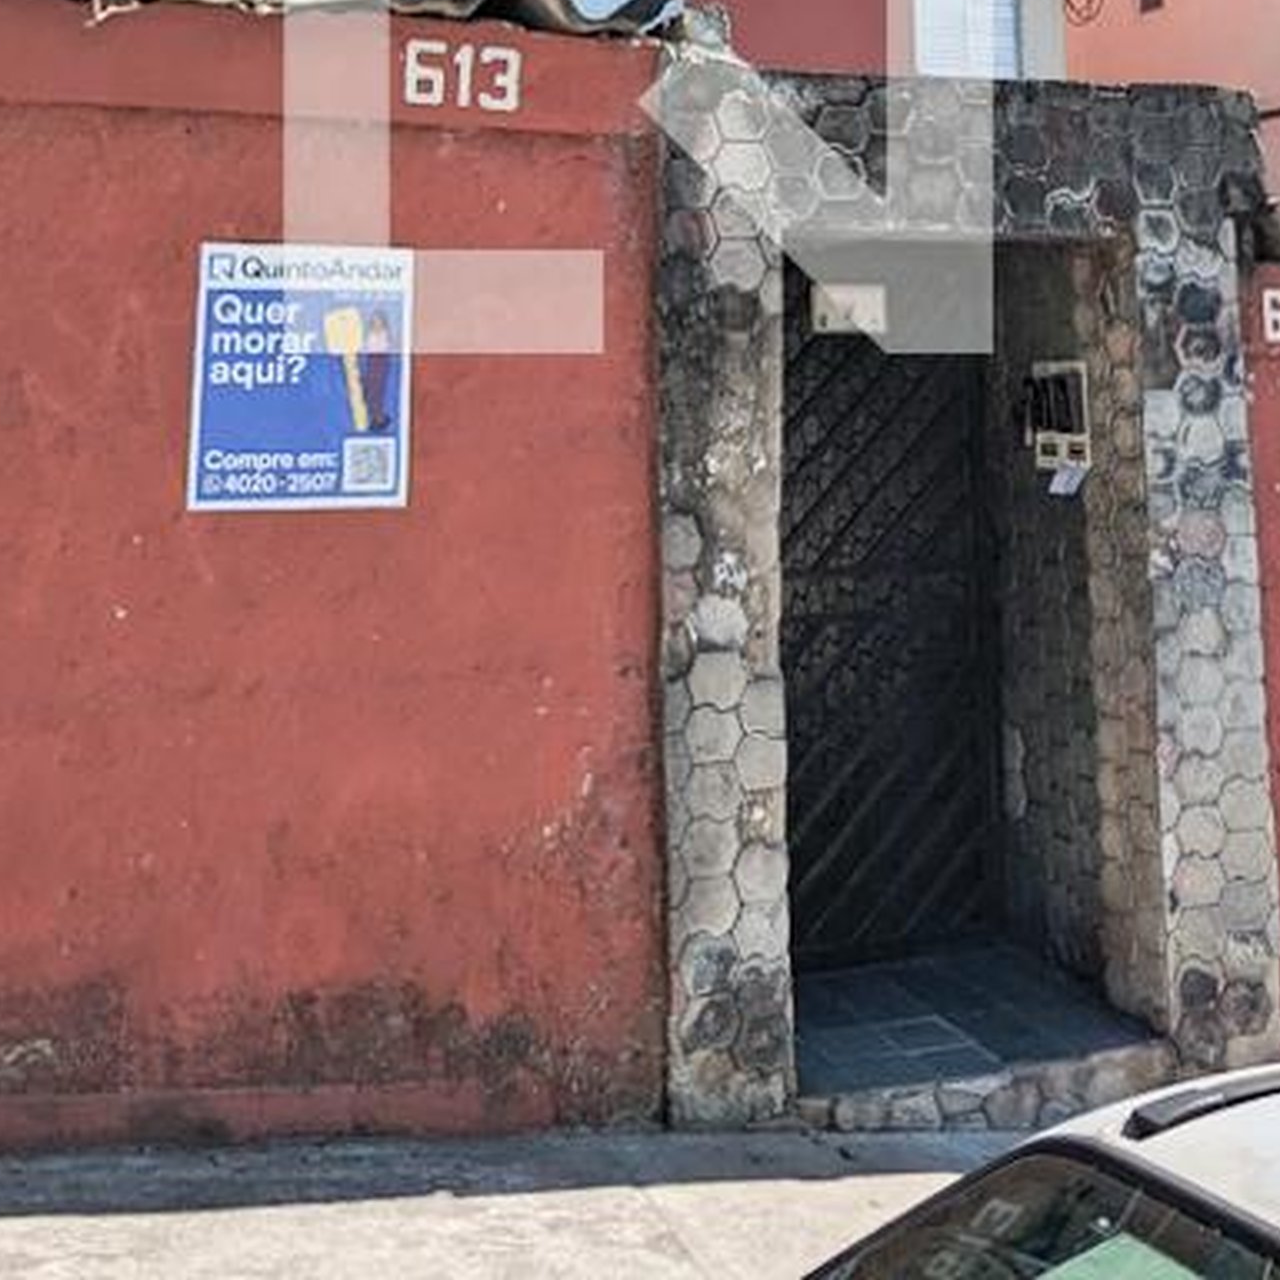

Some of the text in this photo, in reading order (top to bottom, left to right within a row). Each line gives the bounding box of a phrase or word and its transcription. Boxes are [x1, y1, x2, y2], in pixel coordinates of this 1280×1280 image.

[404, 39, 521, 111] 613
[242, 256, 403, 280] QuintoAndar
[213, 294, 302, 326] Quer
[210, 329, 317, 354] morar
[209, 355, 307, 390] aqui?
[204, 450, 295, 474] Compre
